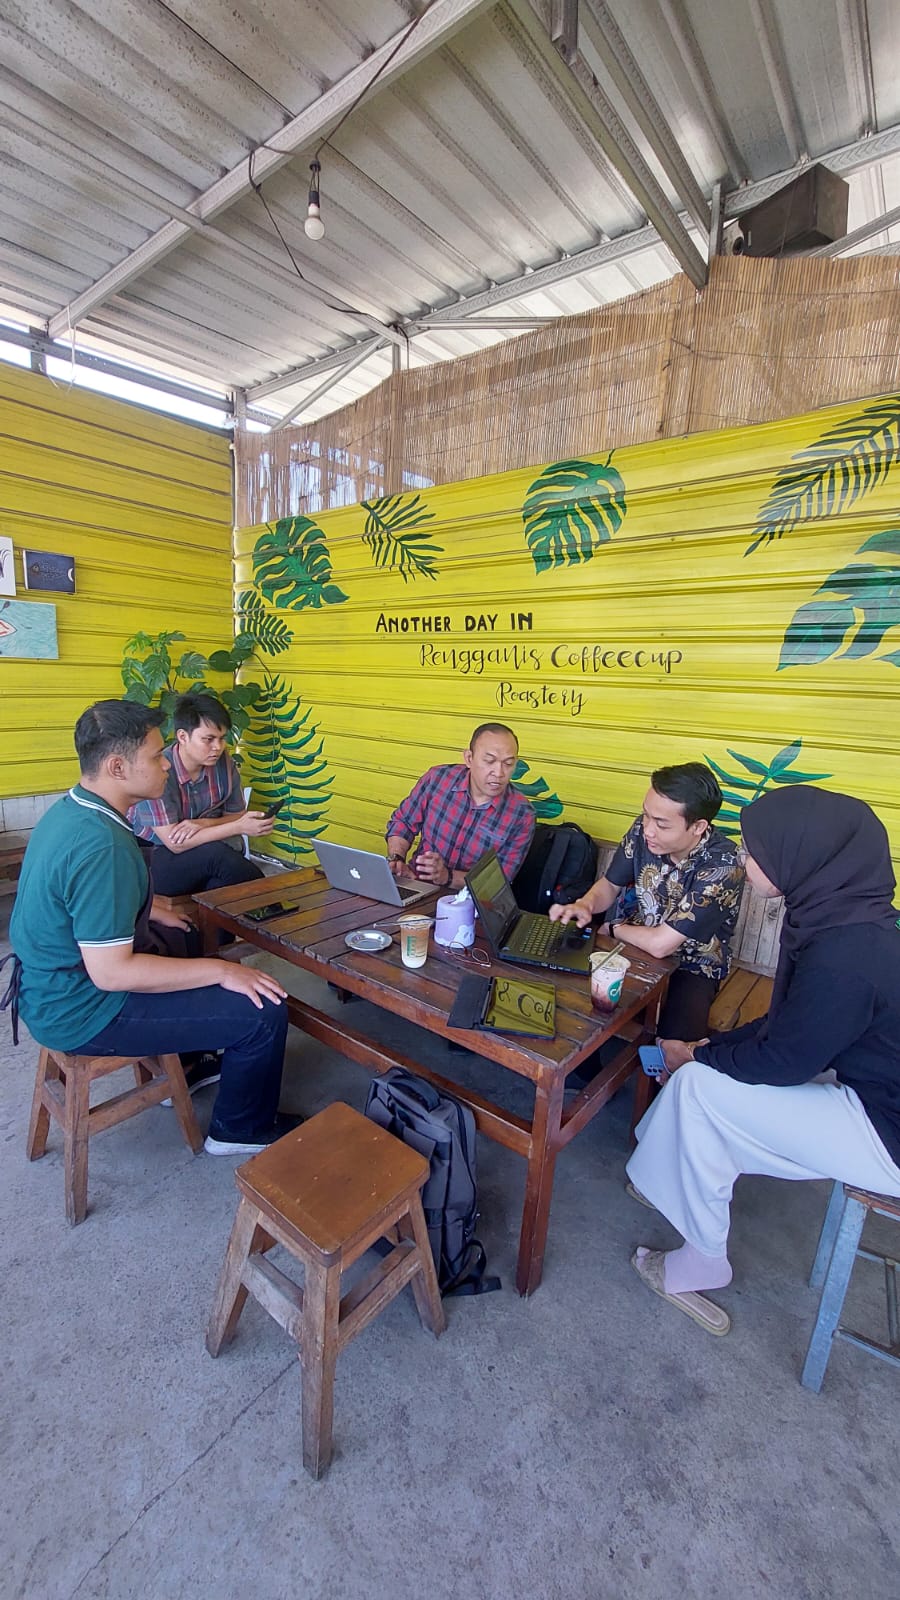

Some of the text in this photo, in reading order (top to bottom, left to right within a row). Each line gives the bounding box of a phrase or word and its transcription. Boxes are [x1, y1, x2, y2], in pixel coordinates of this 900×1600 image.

[375, 612, 533, 633] ANOTHER DAY IN
[419, 643, 683, 674] Rengganis Coffeecup
[495, 681, 589, 717] Roastery
